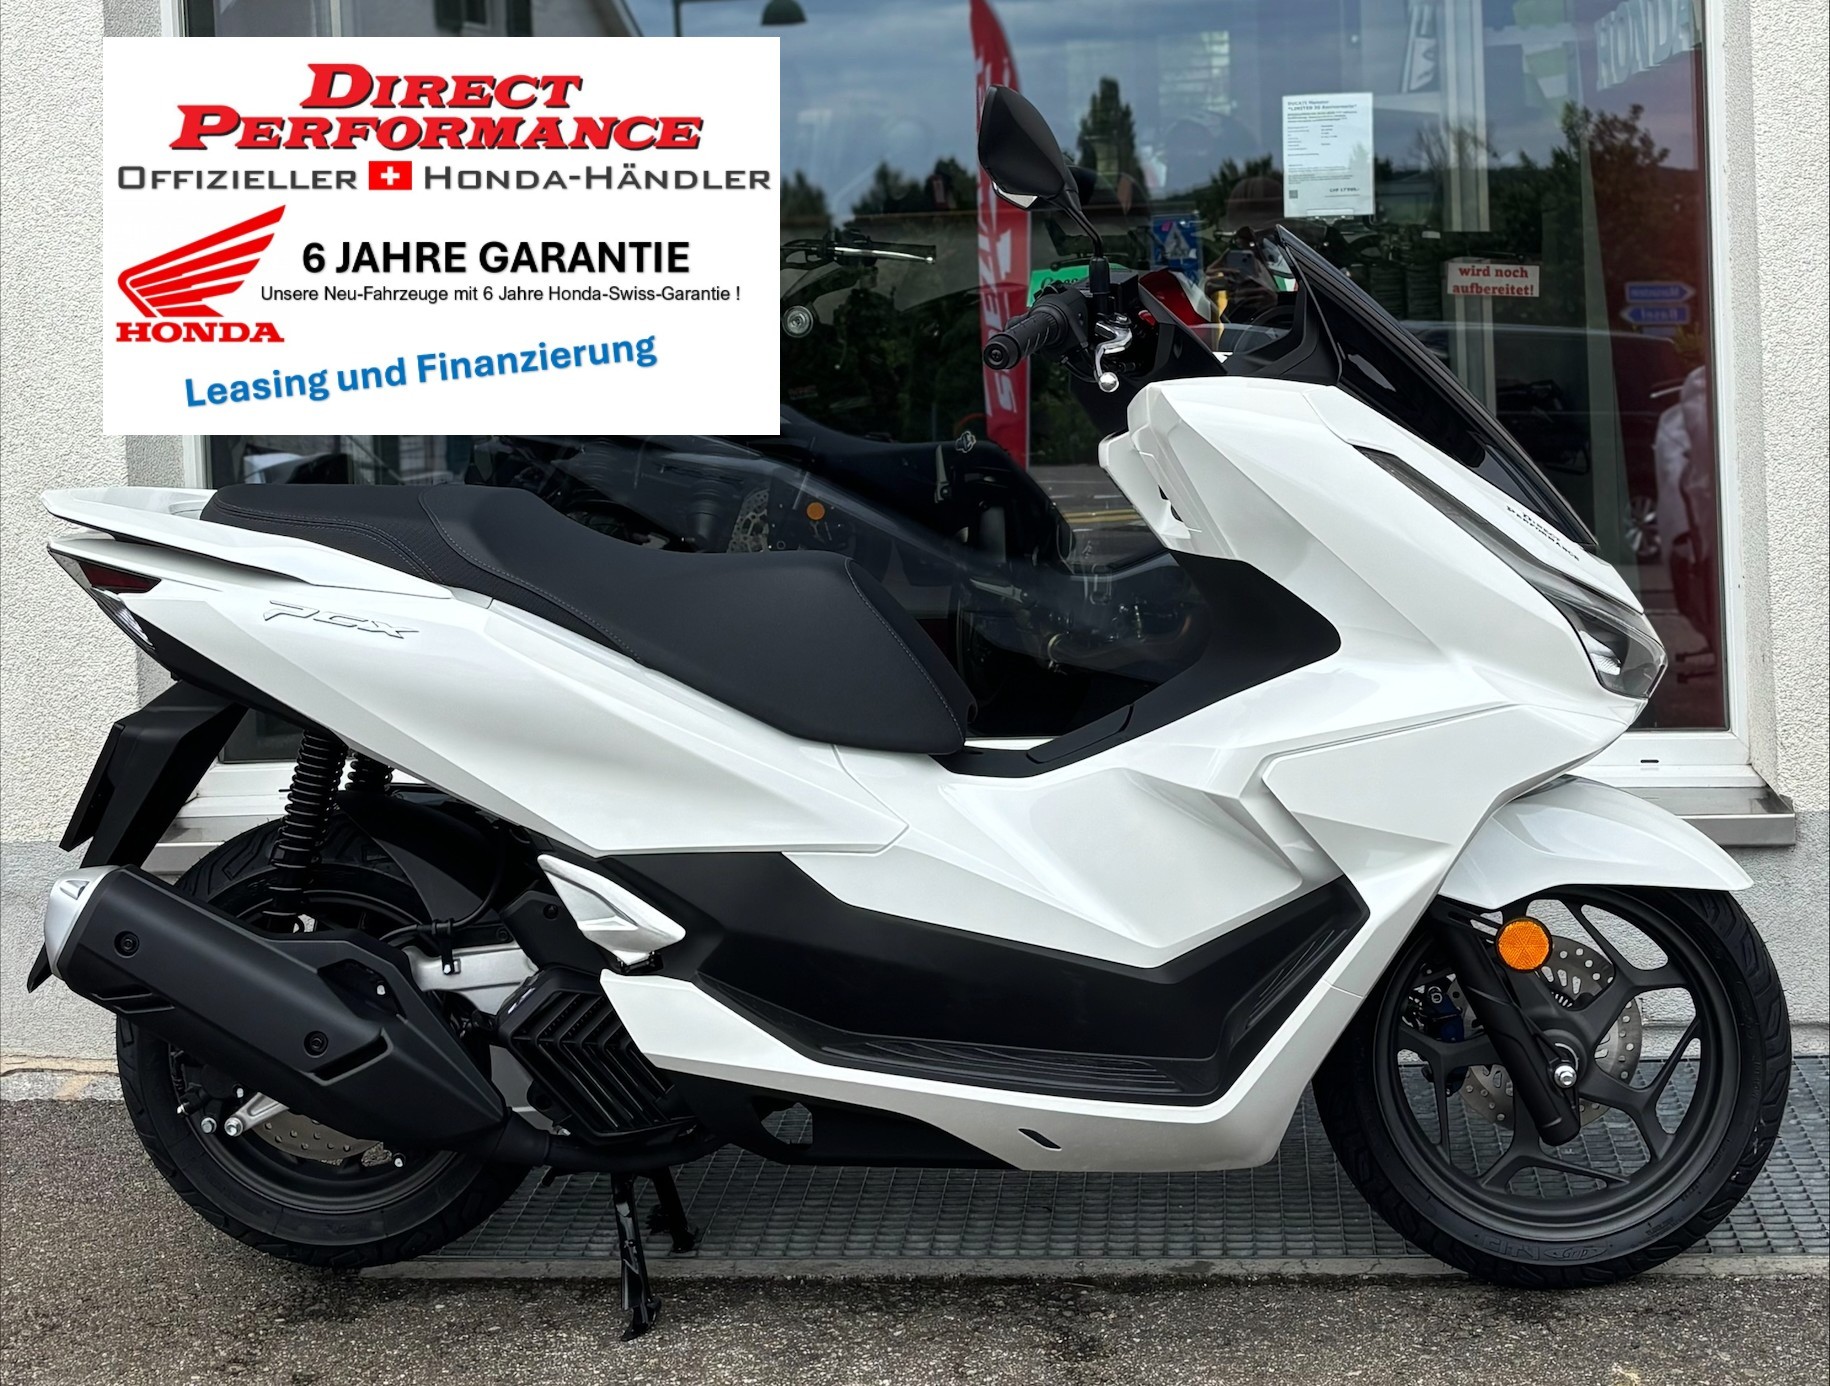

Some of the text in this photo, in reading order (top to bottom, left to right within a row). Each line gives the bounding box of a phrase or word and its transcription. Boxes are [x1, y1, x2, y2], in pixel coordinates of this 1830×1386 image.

[1458, 265, 1528, 279] wird noch
[1453, 283, 1534, 296] aufbereitet!
[263, 600, 419, 639] PCX
